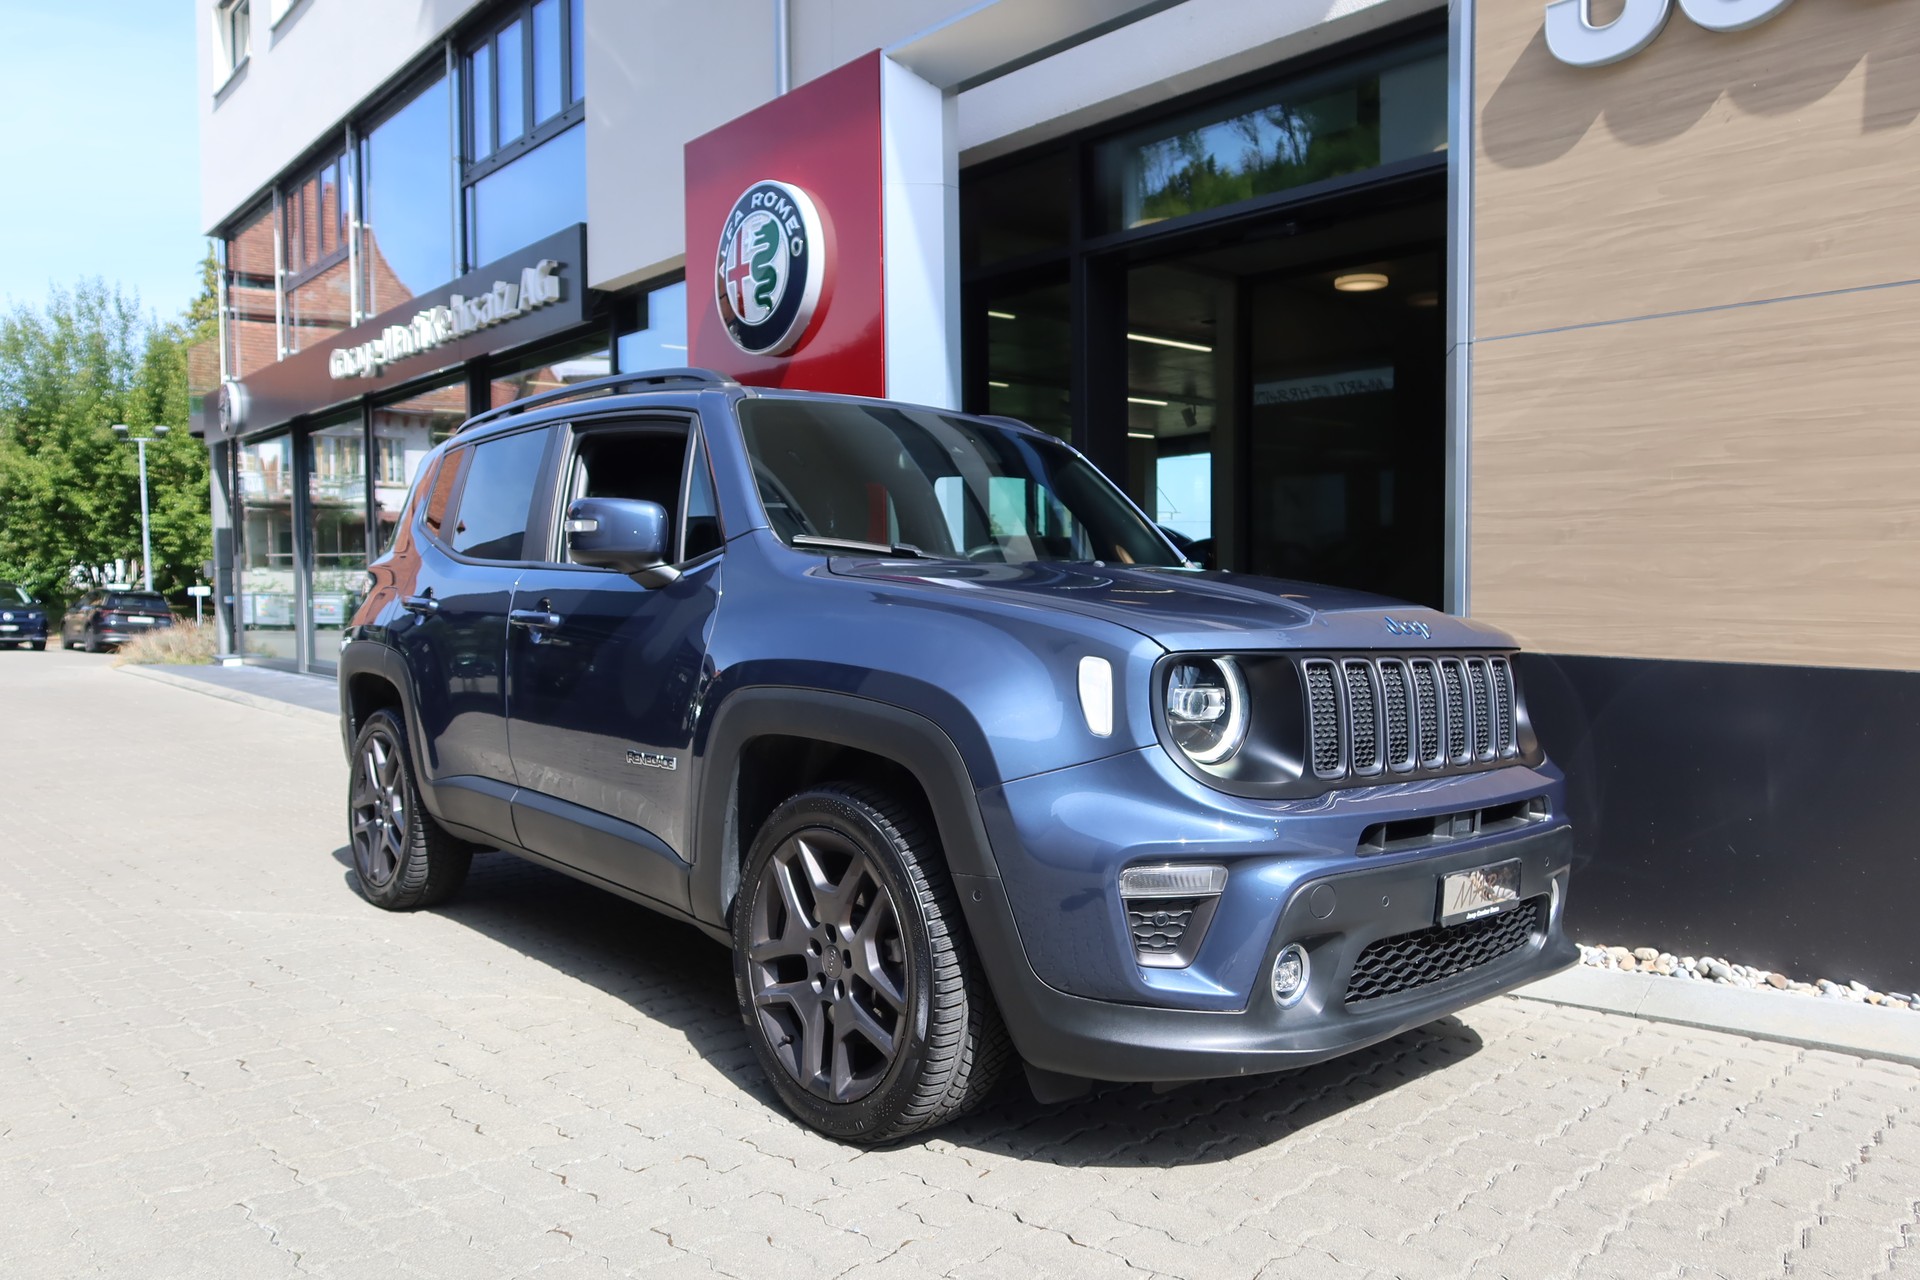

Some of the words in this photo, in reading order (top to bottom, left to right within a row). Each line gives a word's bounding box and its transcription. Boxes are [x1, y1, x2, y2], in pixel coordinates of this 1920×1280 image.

[719, 210, 744, 279] ALFA
[751, 191, 803, 257] ROMEO
[518, 258, 560, 311] AG
[1384, 615, 1432, 640] Jeep
